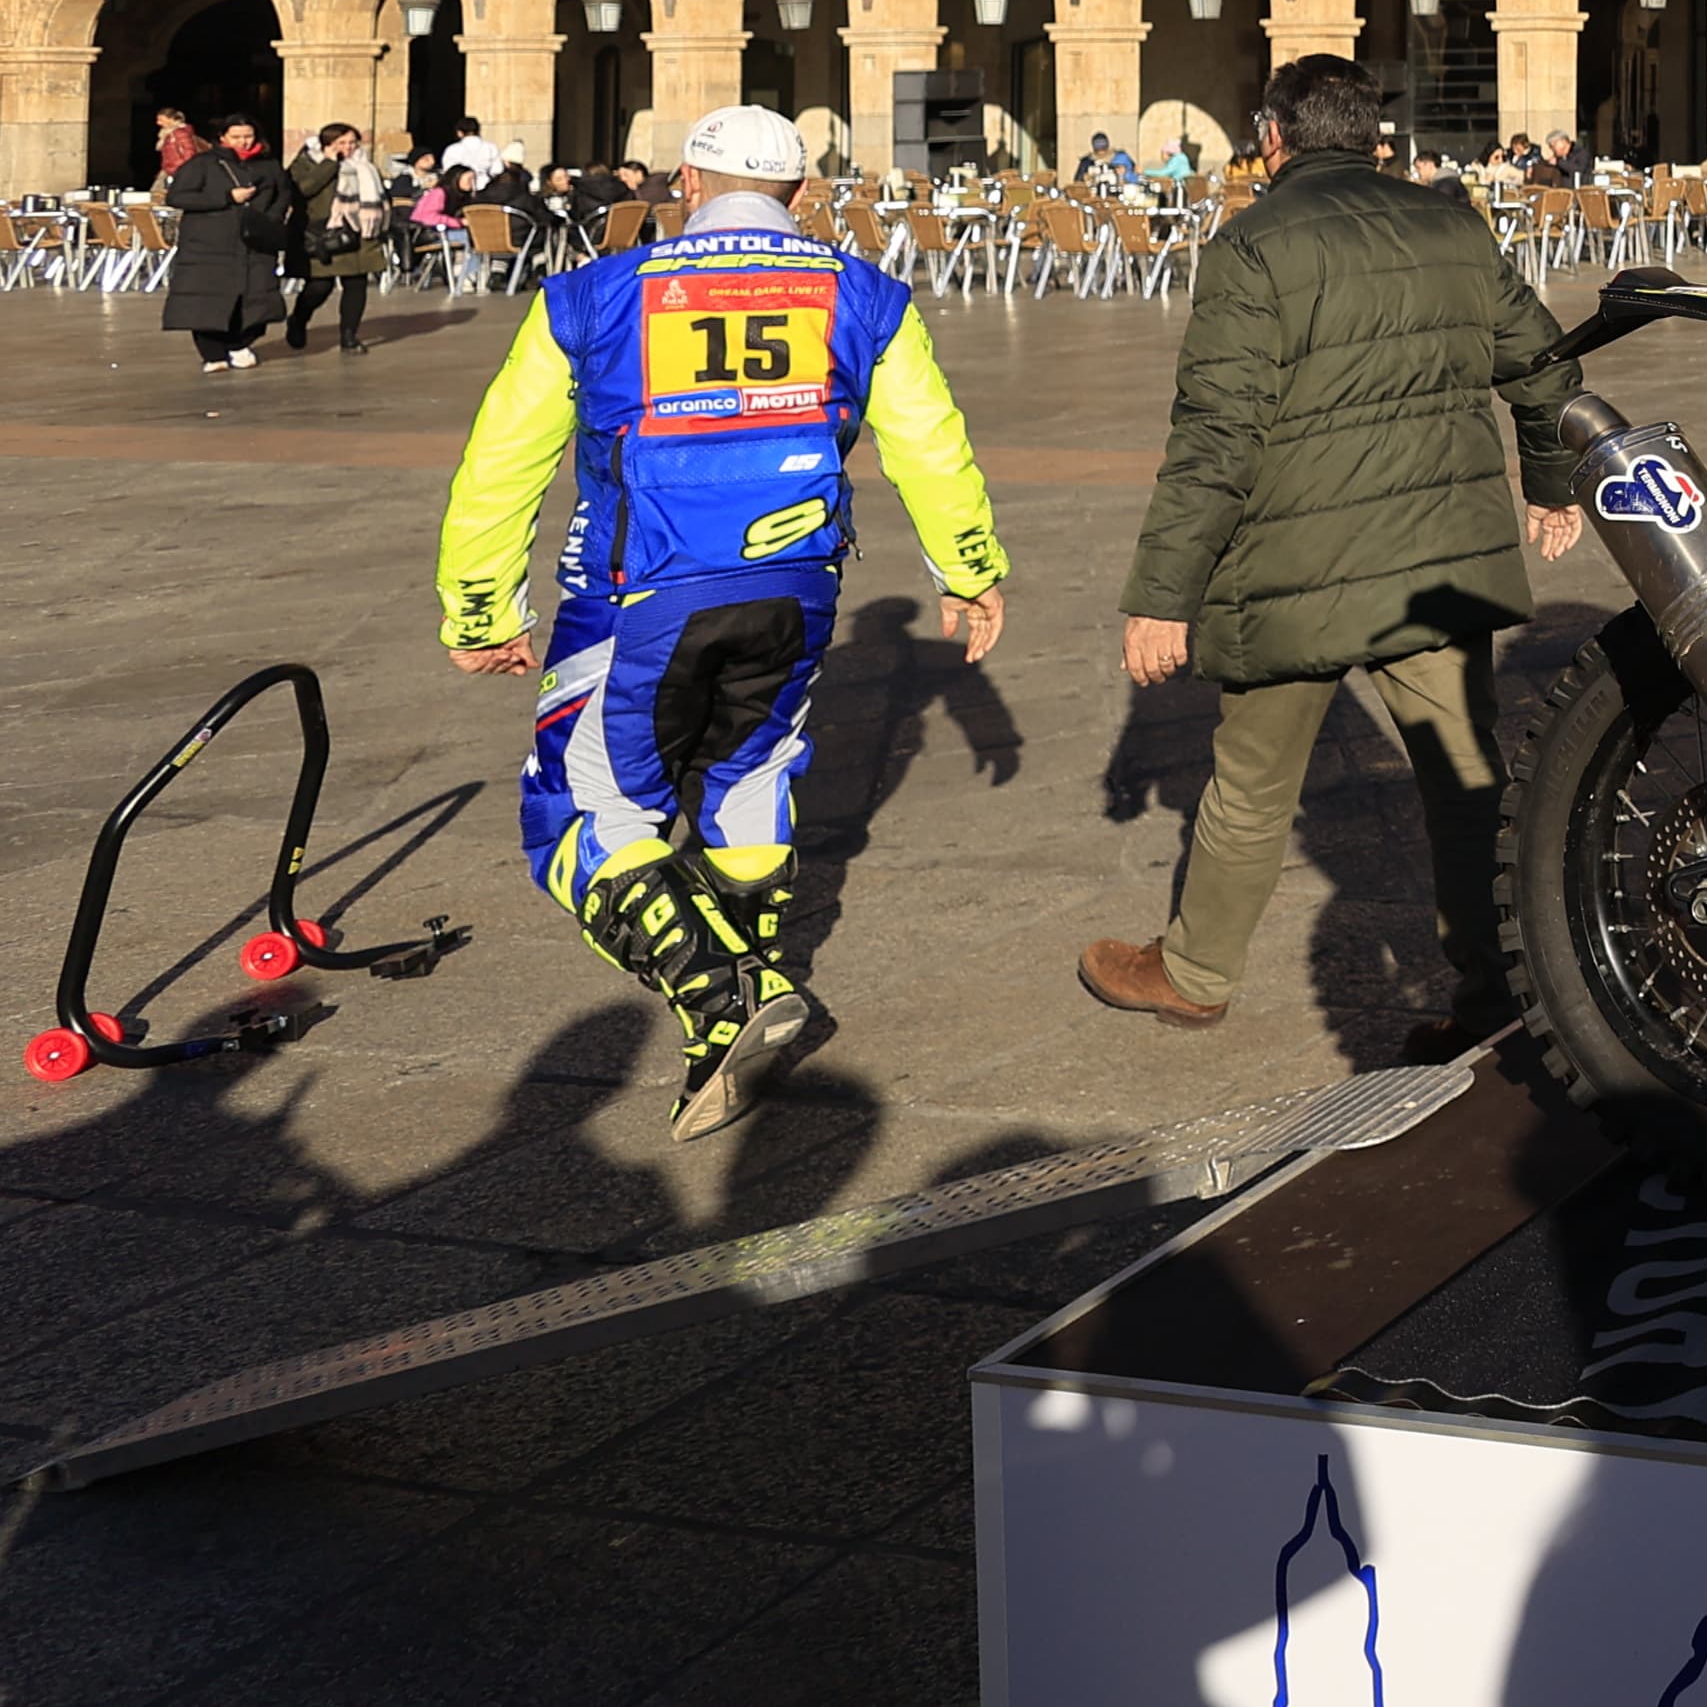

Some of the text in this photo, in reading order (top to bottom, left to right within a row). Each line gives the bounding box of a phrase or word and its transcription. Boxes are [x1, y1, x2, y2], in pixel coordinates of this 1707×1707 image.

[651, 236, 832, 257] SANTOLINO
[636, 254, 845, 275] SHERCO
[690, 314, 790, 383] 15
[658, 392, 818, 414] aramco MOTUL
[1638, 467, 1681, 524] TERMIGNONI
